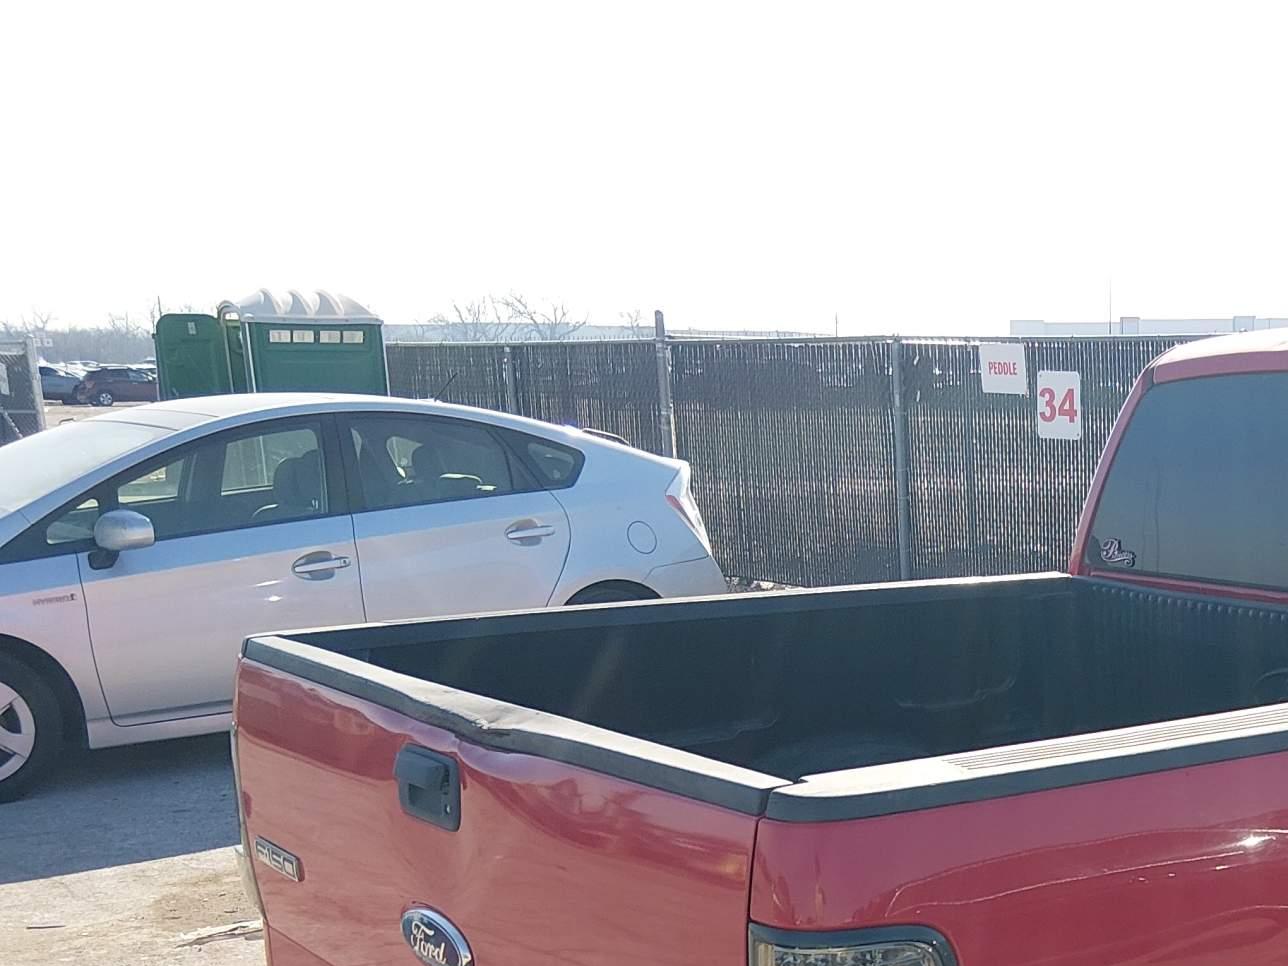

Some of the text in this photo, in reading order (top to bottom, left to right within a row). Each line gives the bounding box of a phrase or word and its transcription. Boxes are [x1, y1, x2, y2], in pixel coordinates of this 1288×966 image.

[988, 361, 1018, 376] PEDDLE
[1039, 387, 1078, 424] 34
[410, 920, 447, 965] Ford
